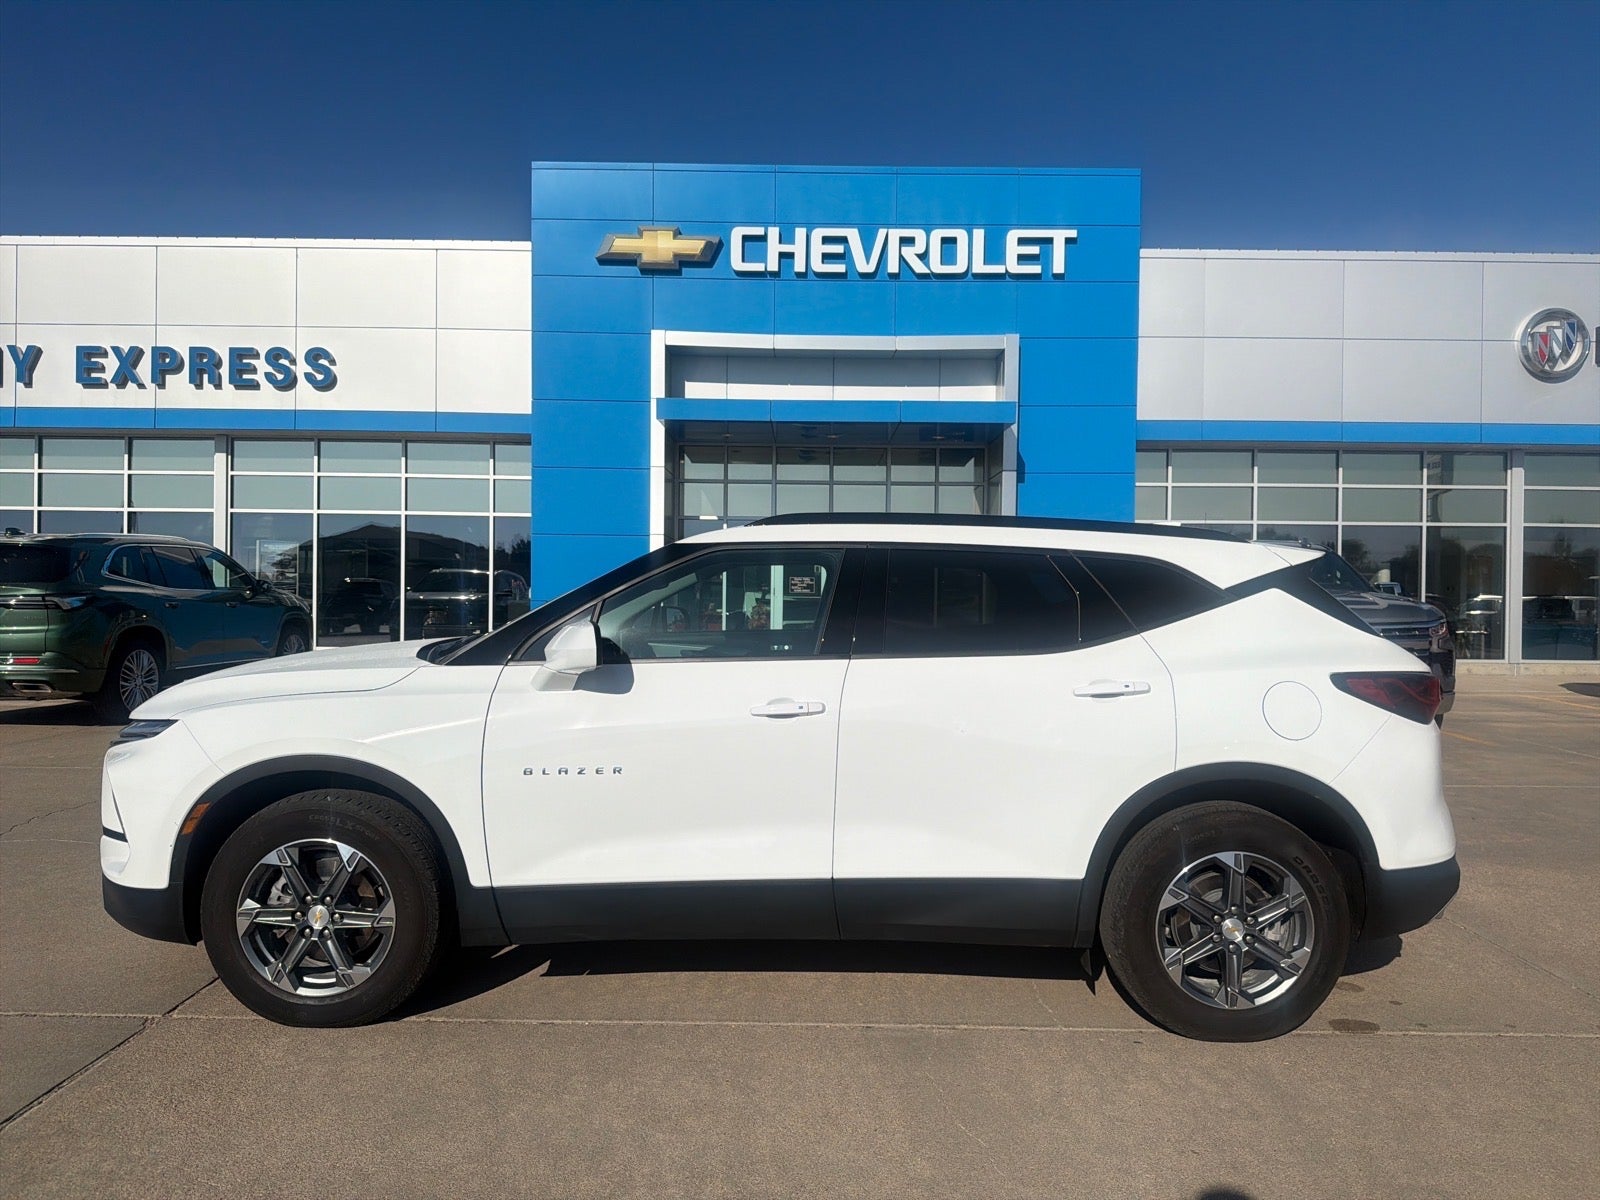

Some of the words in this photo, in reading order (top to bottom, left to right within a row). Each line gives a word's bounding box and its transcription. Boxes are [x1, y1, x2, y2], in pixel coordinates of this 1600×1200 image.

[730, 226, 1078, 276] CHEVROLET
[75, 345, 338, 392] EXPRESS
[522, 766, 623, 776] BLAZER
